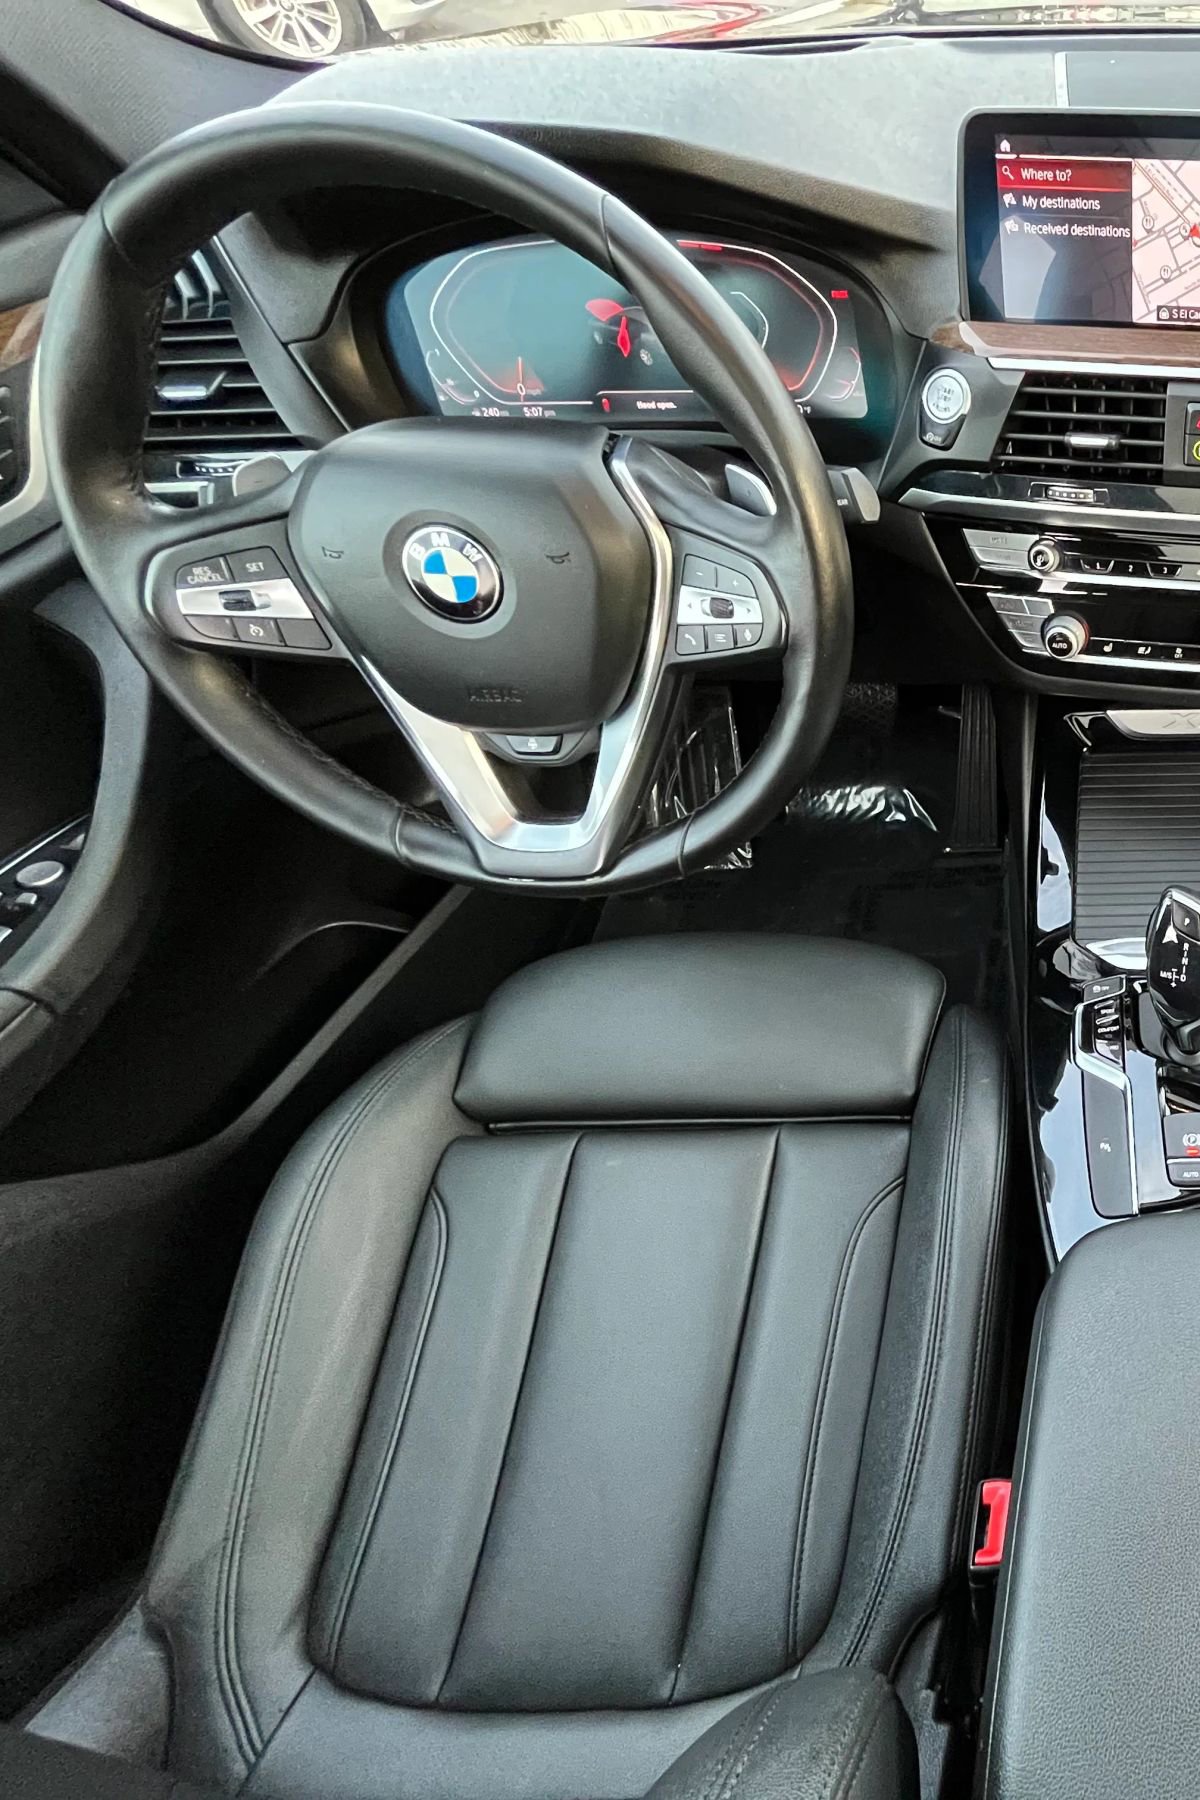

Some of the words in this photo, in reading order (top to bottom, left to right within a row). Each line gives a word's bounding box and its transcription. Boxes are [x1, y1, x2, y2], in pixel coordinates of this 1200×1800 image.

[1020, 167, 1054, 181] Where
[1056, 168, 1072, 182] to?
[1022, 195, 1038, 210] My
[1040, 196, 1101, 210] destinations
[1024, 222, 1068, 236] Received
[1071, 223, 1131, 238] destinations
[1171, 309, 1178, 319] S
[481, 407, 500, 416] 240
[523, 407, 543, 416] 5:07
[408, 531, 484, 563] BMW
[245, 561, 265, 573] SET
[187, 573, 224, 584] CANCEL
[1184, 917, 1190, 926] P
